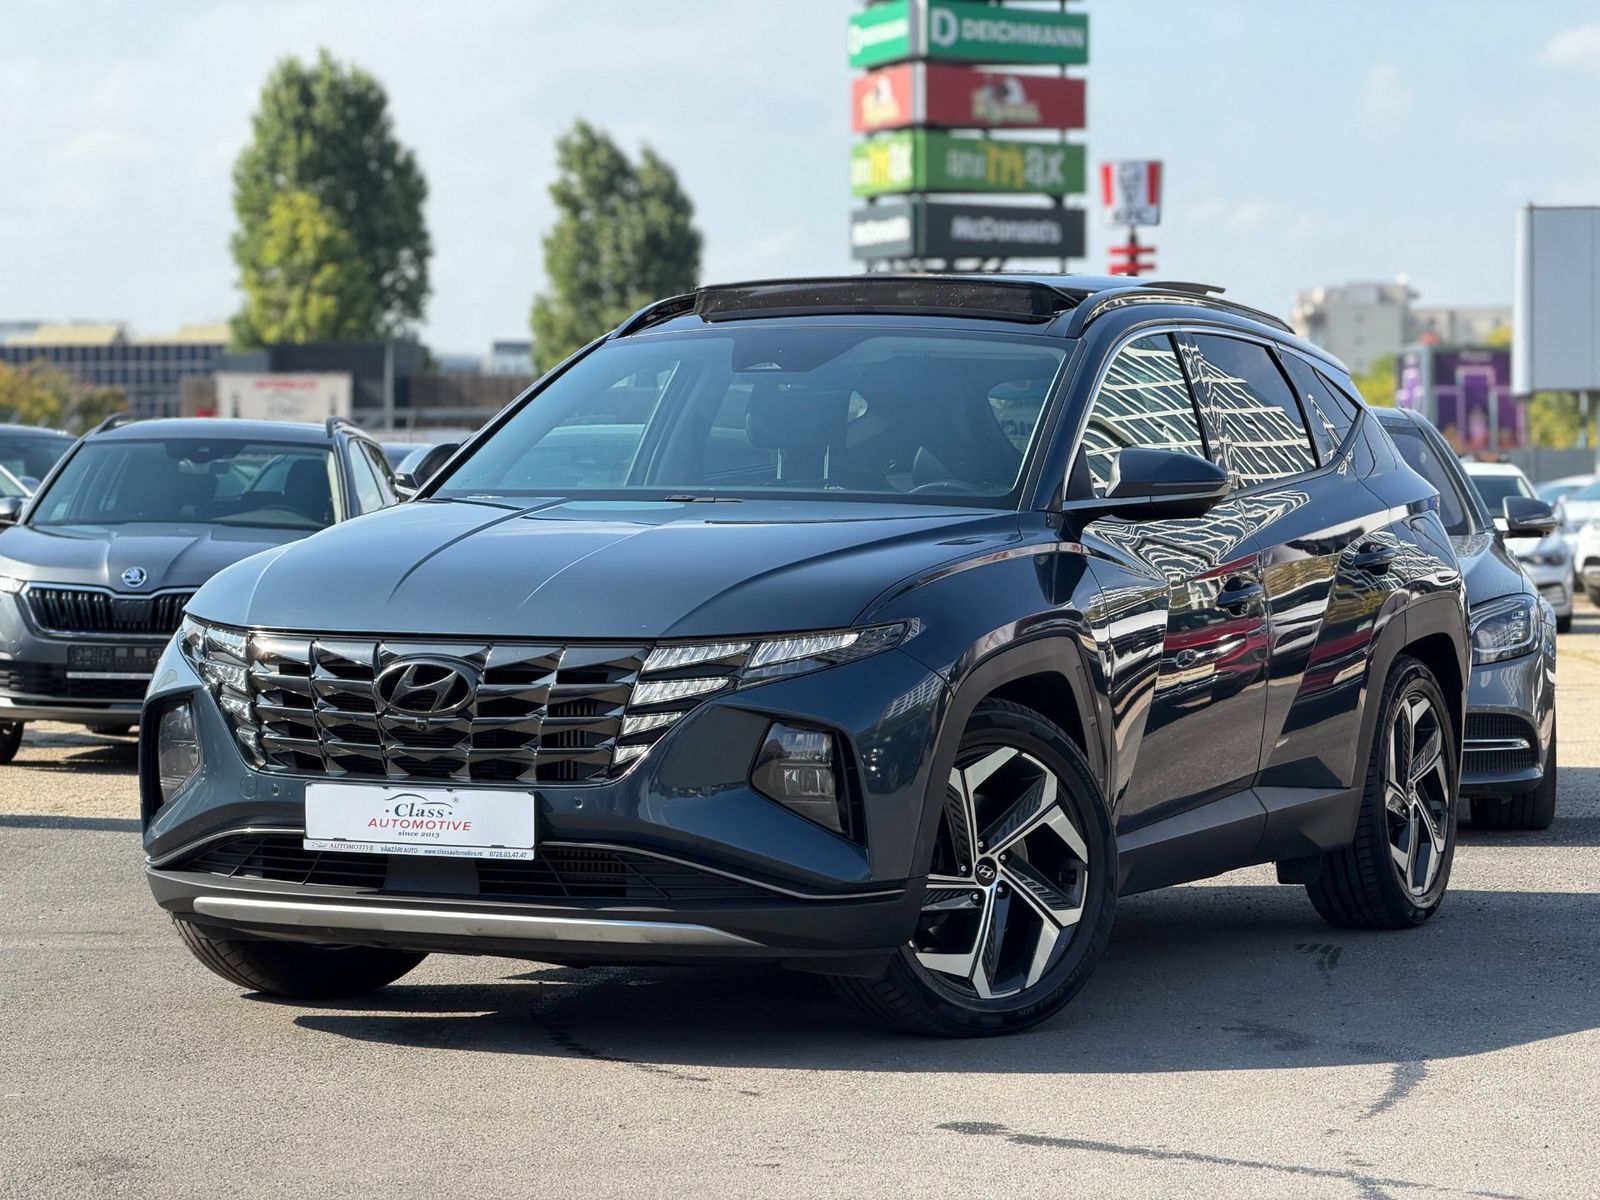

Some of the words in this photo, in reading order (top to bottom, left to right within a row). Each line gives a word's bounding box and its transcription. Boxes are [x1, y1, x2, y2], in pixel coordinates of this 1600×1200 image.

[930, 7, 959, 47] D
[961, 18, 1084, 47] DEICHMANN
[951, 216, 1062, 245] McDonald's
[394, 802, 445, 819] Class
[367, 817, 473, 832] AUTOMOTIVE
[398, 830, 420, 838] since
[329, 842, 375, 851] AUTOMOTIVE
